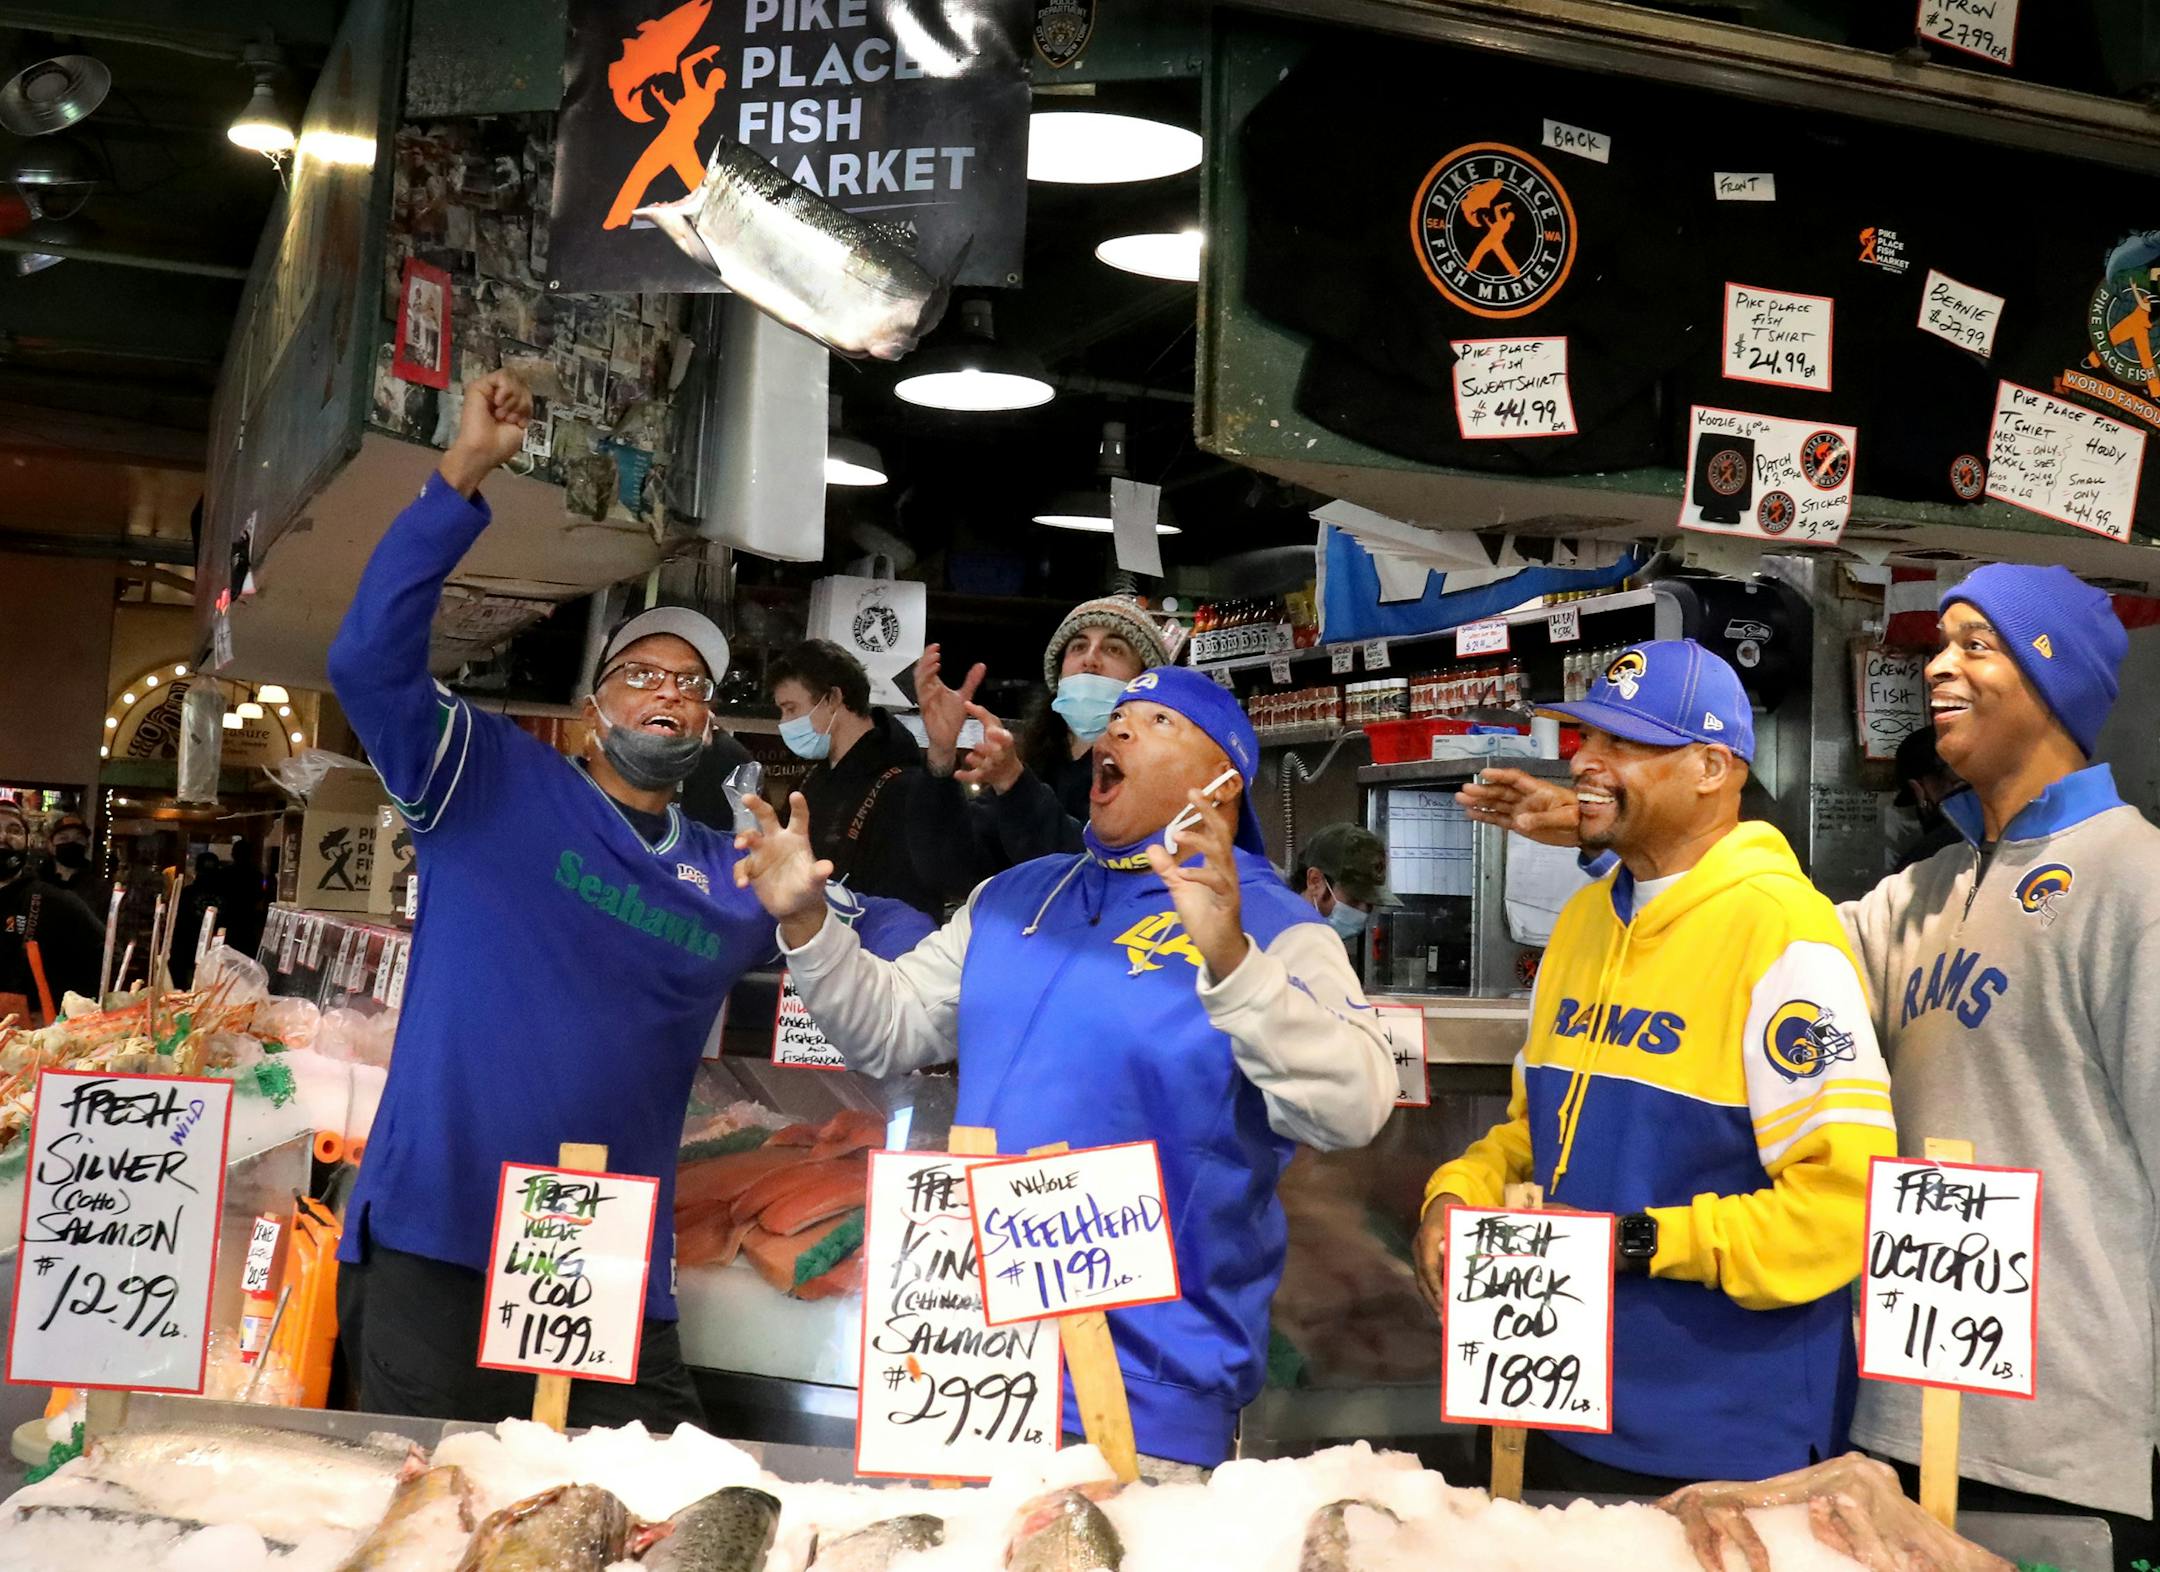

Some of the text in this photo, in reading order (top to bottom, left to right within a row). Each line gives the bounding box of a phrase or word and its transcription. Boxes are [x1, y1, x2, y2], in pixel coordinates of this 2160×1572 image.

[744, 0, 867, 33] PIKE
[741, 38, 924, 90] PLACE
[1991, 46, 2008, 60] EA
[738, 98, 862, 145] FISH
[1554, 126, 1601, 153] BACK
[769, 147, 976, 198] ARKET
[1719, 176, 1761, 194] FRONT
[1431, 159, 1559, 220] PIKE PLACE
[1426, 217, 1447, 230] SEA
[1543, 230, 1563, 243] WA
[1877, 228, 1897, 240] PIKE
[1876, 246, 1896, 257] FISH
[1877, 237, 1905, 250] PLACE
[1431, 239, 1558, 300] FISH MARKET
[1875, 254, 1910, 269] MARKET
[1736, 292, 1814, 318] PIKE PLACE
[1930, 283, 1995, 322] BEANIE
[1752, 313, 1784, 328] FISH
[2091, 288, 2157, 381] PIKE PLACE FISH
[1768, 329, 1817, 343] SHIRT
[1461, 342, 1545, 361] PIKE PLACE
[1489, 358, 1523, 374] FISH
[1733, 333, 1816, 378] $24.99 EA
[1461, 372, 1567, 398] SWEATSHIRT
[2066, 372, 2160, 426] WORLD FAMOU
[1470, 399, 1557, 428] $44.99
[1697, 410, 1738, 428] KOOZIE
[2013, 389, 2120, 435] PIKE PLACE FISH
[1992, 430, 2017, 444] MED
[2014, 419, 2057, 440] SHIRT
[1990, 455, 2027, 472] XXXL
[1995, 443, 2060, 457] XXL ONLY
[2085, 437, 2129, 465] HOODY
[1755, 452, 1793, 481] PATCH
[1800, 494, 1850, 514] STICKER
[2073, 491, 2101, 503] ONLY
[1867, 658, 1920, 680] CREWS
[1870, 682, 1918, 704] FISH
[223, 729, 271, 740] easure
[358, 827, 376, 840] PI
[555, 850, 721, 961] Seahawks
[1901, 948, 2010, 1030] RAMS
[779, 1015, 817, 1030] CAUGH
[782, 1028, 829, 1045] FISHER
[1550, 998, 1687, 1055] RAMS
[61, 1079, 188, 1129] FRESH
[170, 1100, 205, 1147] WILD
[37, 1132, 199, 1194] SILVER
[516, 1174, 618, 1218] FRESH
[907, 1163, 971, 1213] FRE
[1009, 1169, 1081, 1198] WHOLE
[1893, 1167, 2020, 1223] FRESH
[51, 1182, 131, 1216] (COHO)
[24, 1205, 184, 1255] SALMON
[981, 1192, 1163, 1257] STEELHEAD
[1464, 1215, 1571, 1258] FRESH
[504, 1241, 586, 1279] LING
[1870, 1230, 2029, 1294] OCTOPUS
[529, 1274, 593, 1308] COD
[1457, 1253, 1585, 1305] BLACK
[1493, 1302, 1558, 1340] COD
[872, 1313, 1042, 1360] SALMON
